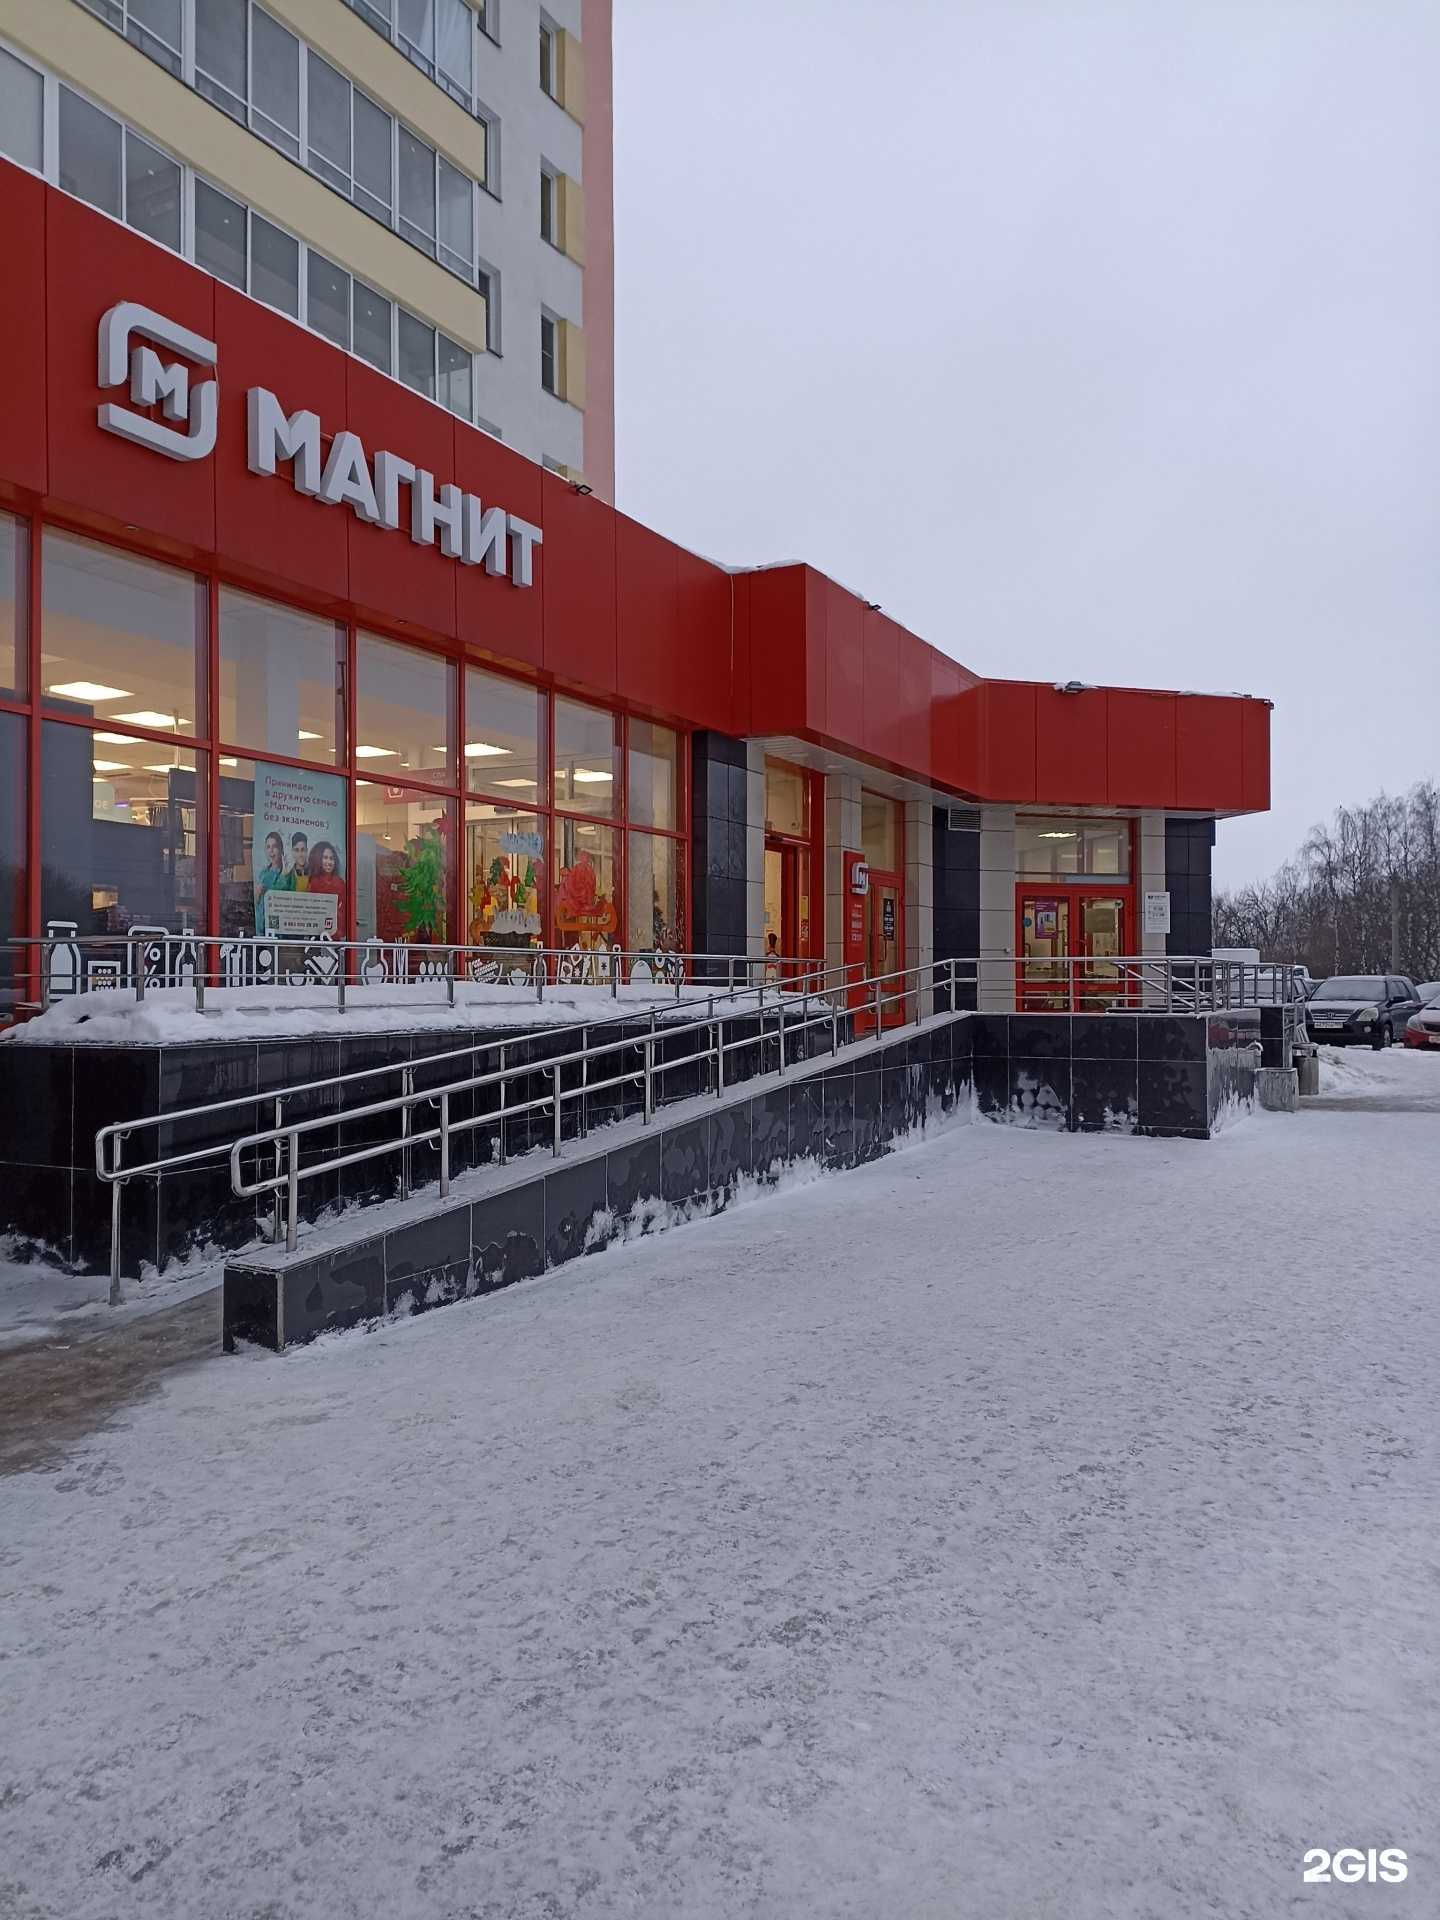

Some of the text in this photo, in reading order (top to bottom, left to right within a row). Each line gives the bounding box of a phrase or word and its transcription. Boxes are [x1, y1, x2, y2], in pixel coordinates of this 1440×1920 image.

[247, 386, 543, 588] МАГНИТ
[265, 776, 314, 791] Принимаем
[272, 791, 311, 803] дружную
[312, 798, 338, 807] семью
[264, 812, 279, 822] без
